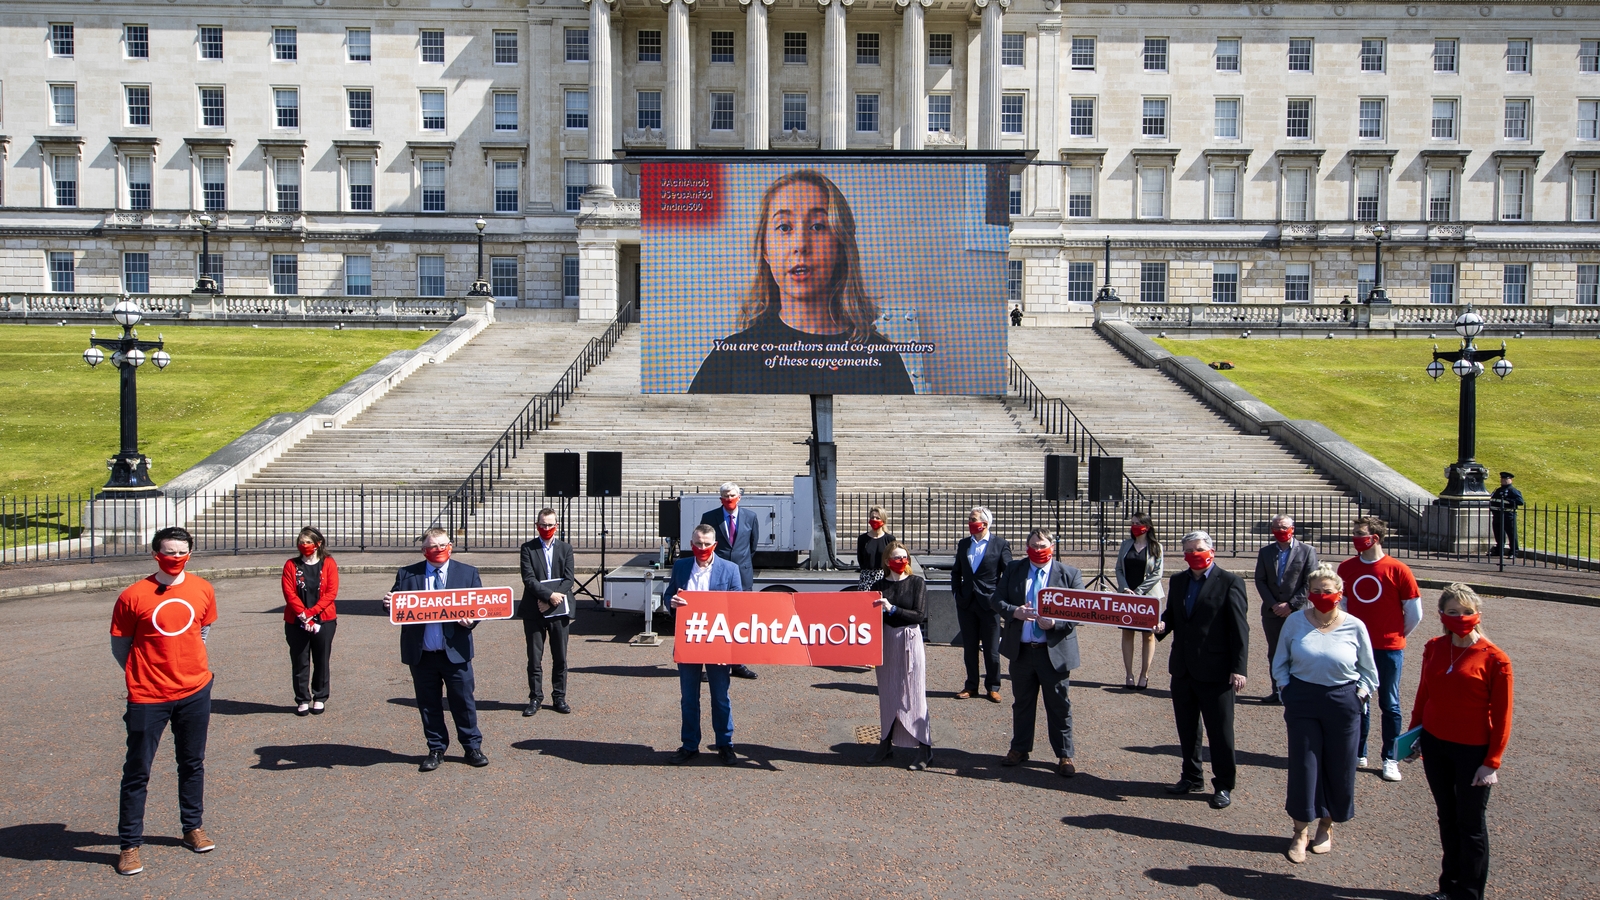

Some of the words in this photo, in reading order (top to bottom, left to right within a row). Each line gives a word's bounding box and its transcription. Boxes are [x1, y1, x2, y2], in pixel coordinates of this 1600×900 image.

[715, 340, 737, 351] You
[739, 343, 759, 352] are
[760, 340, 823, 352] co-authors
[825, 341, 848, 352] and
[850, 342, 934, 354] co-guarantors
[764, 355, 779, 369] of
[779, 355, 808, 366] these
[810, 357, 882, 368] agreements.
[685, 612, 872, 645] #AchtAnois
